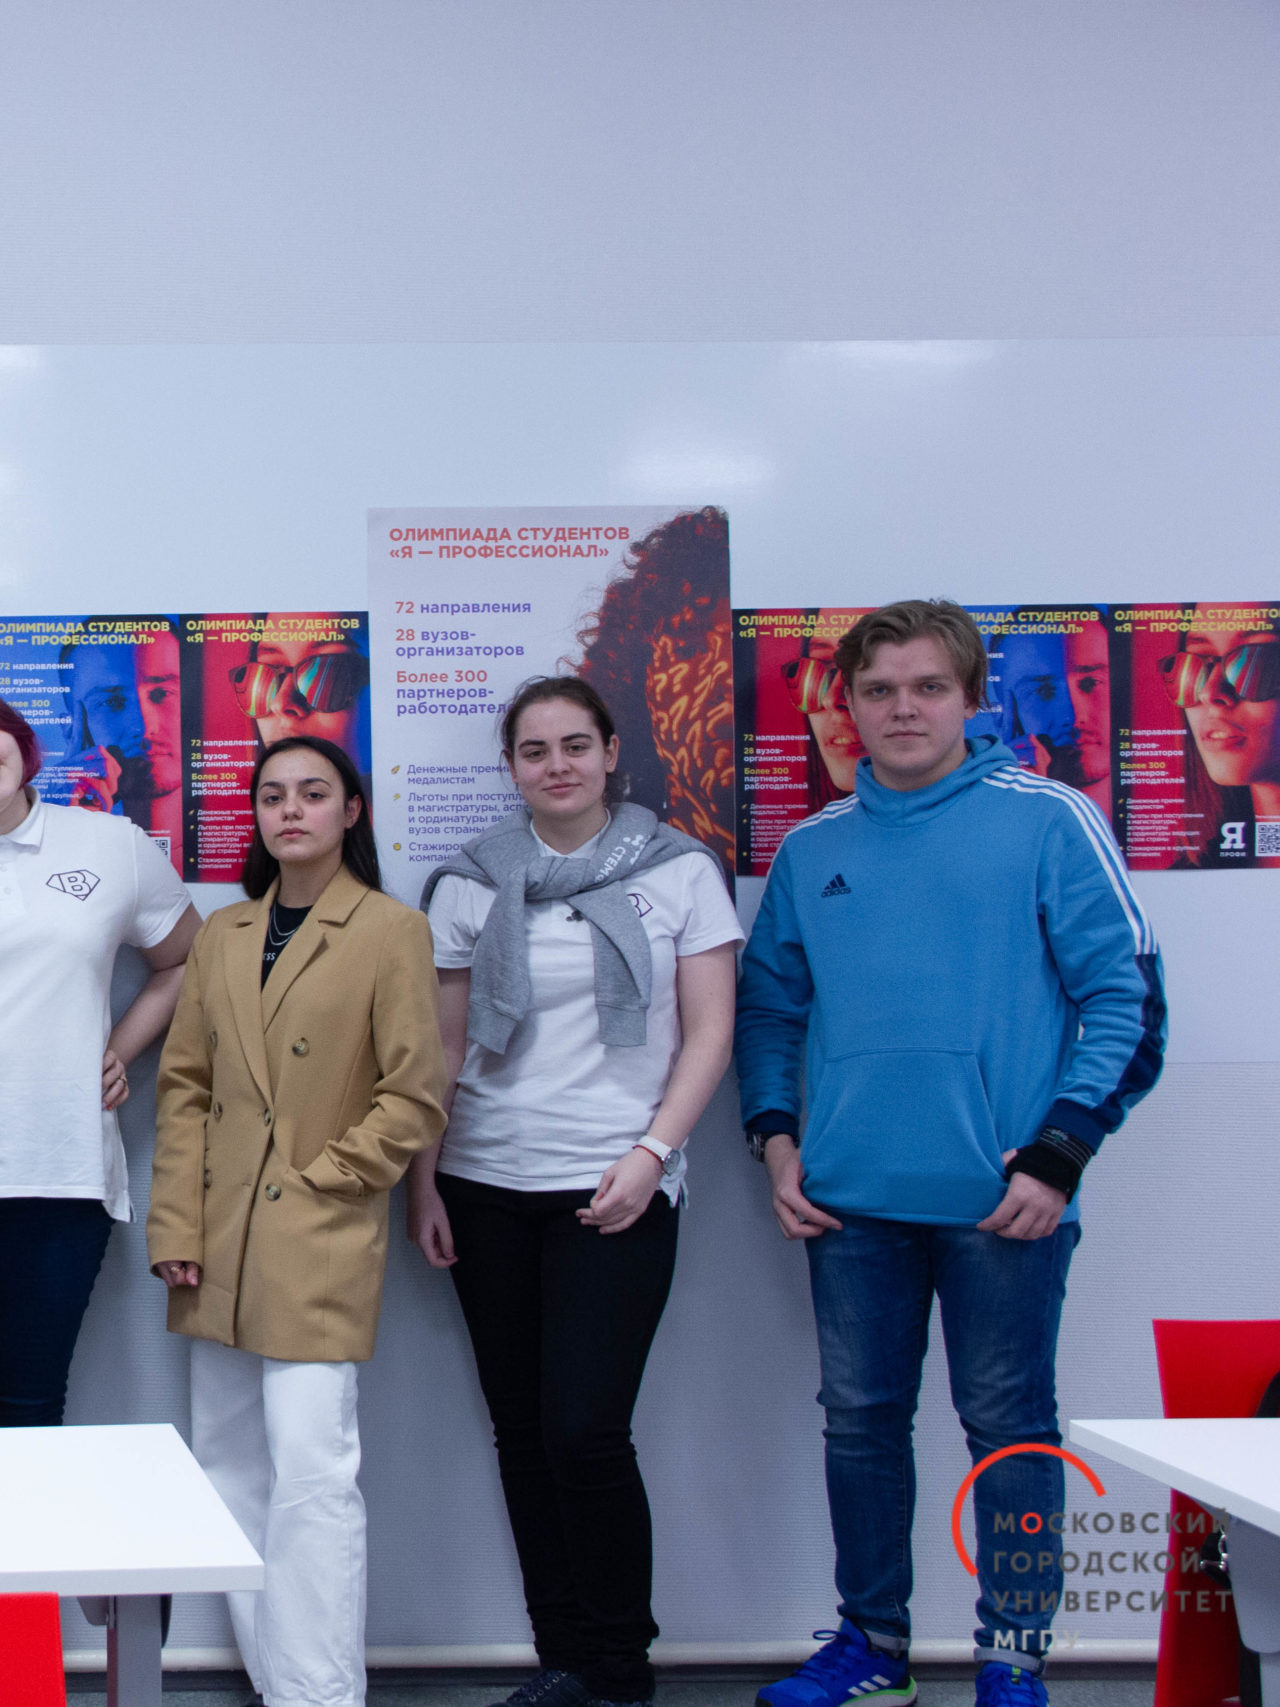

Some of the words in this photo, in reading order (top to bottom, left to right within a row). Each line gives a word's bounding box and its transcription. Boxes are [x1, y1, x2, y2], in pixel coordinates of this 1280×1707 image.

[389, 528, 512, 542] ОЛИМПИАДА
[517, 527, 630, 542] СТУДЕНТОВ
[390, 546, 412, 558] «Я
[439, 545, 609, 558] ПРОФЕССИОНАЛ»
[395, 601, 414, 614] 72
[421, 603, 531, 615] направления
[1114, 609, 1203, 620] ОЛИМПИАДА
[1207, 608, 1280, 619] СТУДЕНТО
[739, 614, 826, 626] ОЛИМПИАДА
[1018, 611, 1099, 622] СТУДЕНТОВ
[88, 621, 170, 633] СТУДЕНТОВ
[186, 619, 274, 631] ОЛИМПИАДА
[278, 618, 360, 630] СТУДЕНТОВ
[1115, 623, 1132, 633] «Я
[1150, 621, 1273, 632] ПРОФЕССИОНАЛ»
[186, 633, 203, 643] «Я
[222, 631, 345, 643] ПРОФЕССИОНАЛ»
[395, 629, 415, 641] 28
[421, 631, 476, 643] вузов-
[739, 628, 756, 638] «Я
[31, 634, 155, 646] ПРОФЕССИОНАЛ»
[395, 646, 524, 658] организаторов
[0, 677, 11, 685] 28
[396, 671, 448, 683] Более
[454, 670, 488, 682] 300
[397, 688, 494, 700] партнеров-
[407, 765, 468, 775] Денежные
[408, 777, 475, 785] медалистам
[744, 782, 808, 791] работодателей
[1121, 777, 1185, 786] работодателей
[408, 793, 449, 802] Льготы
[452, 795, 473, 803] при
[418, 804, 500, 814] магистратуры,
[419, 815, 488, 825] ординатуры
[409, 827, 440, 836] вузов
[444, 826, 485, 835] страны
[1220, 822, 1246, 849] Я
